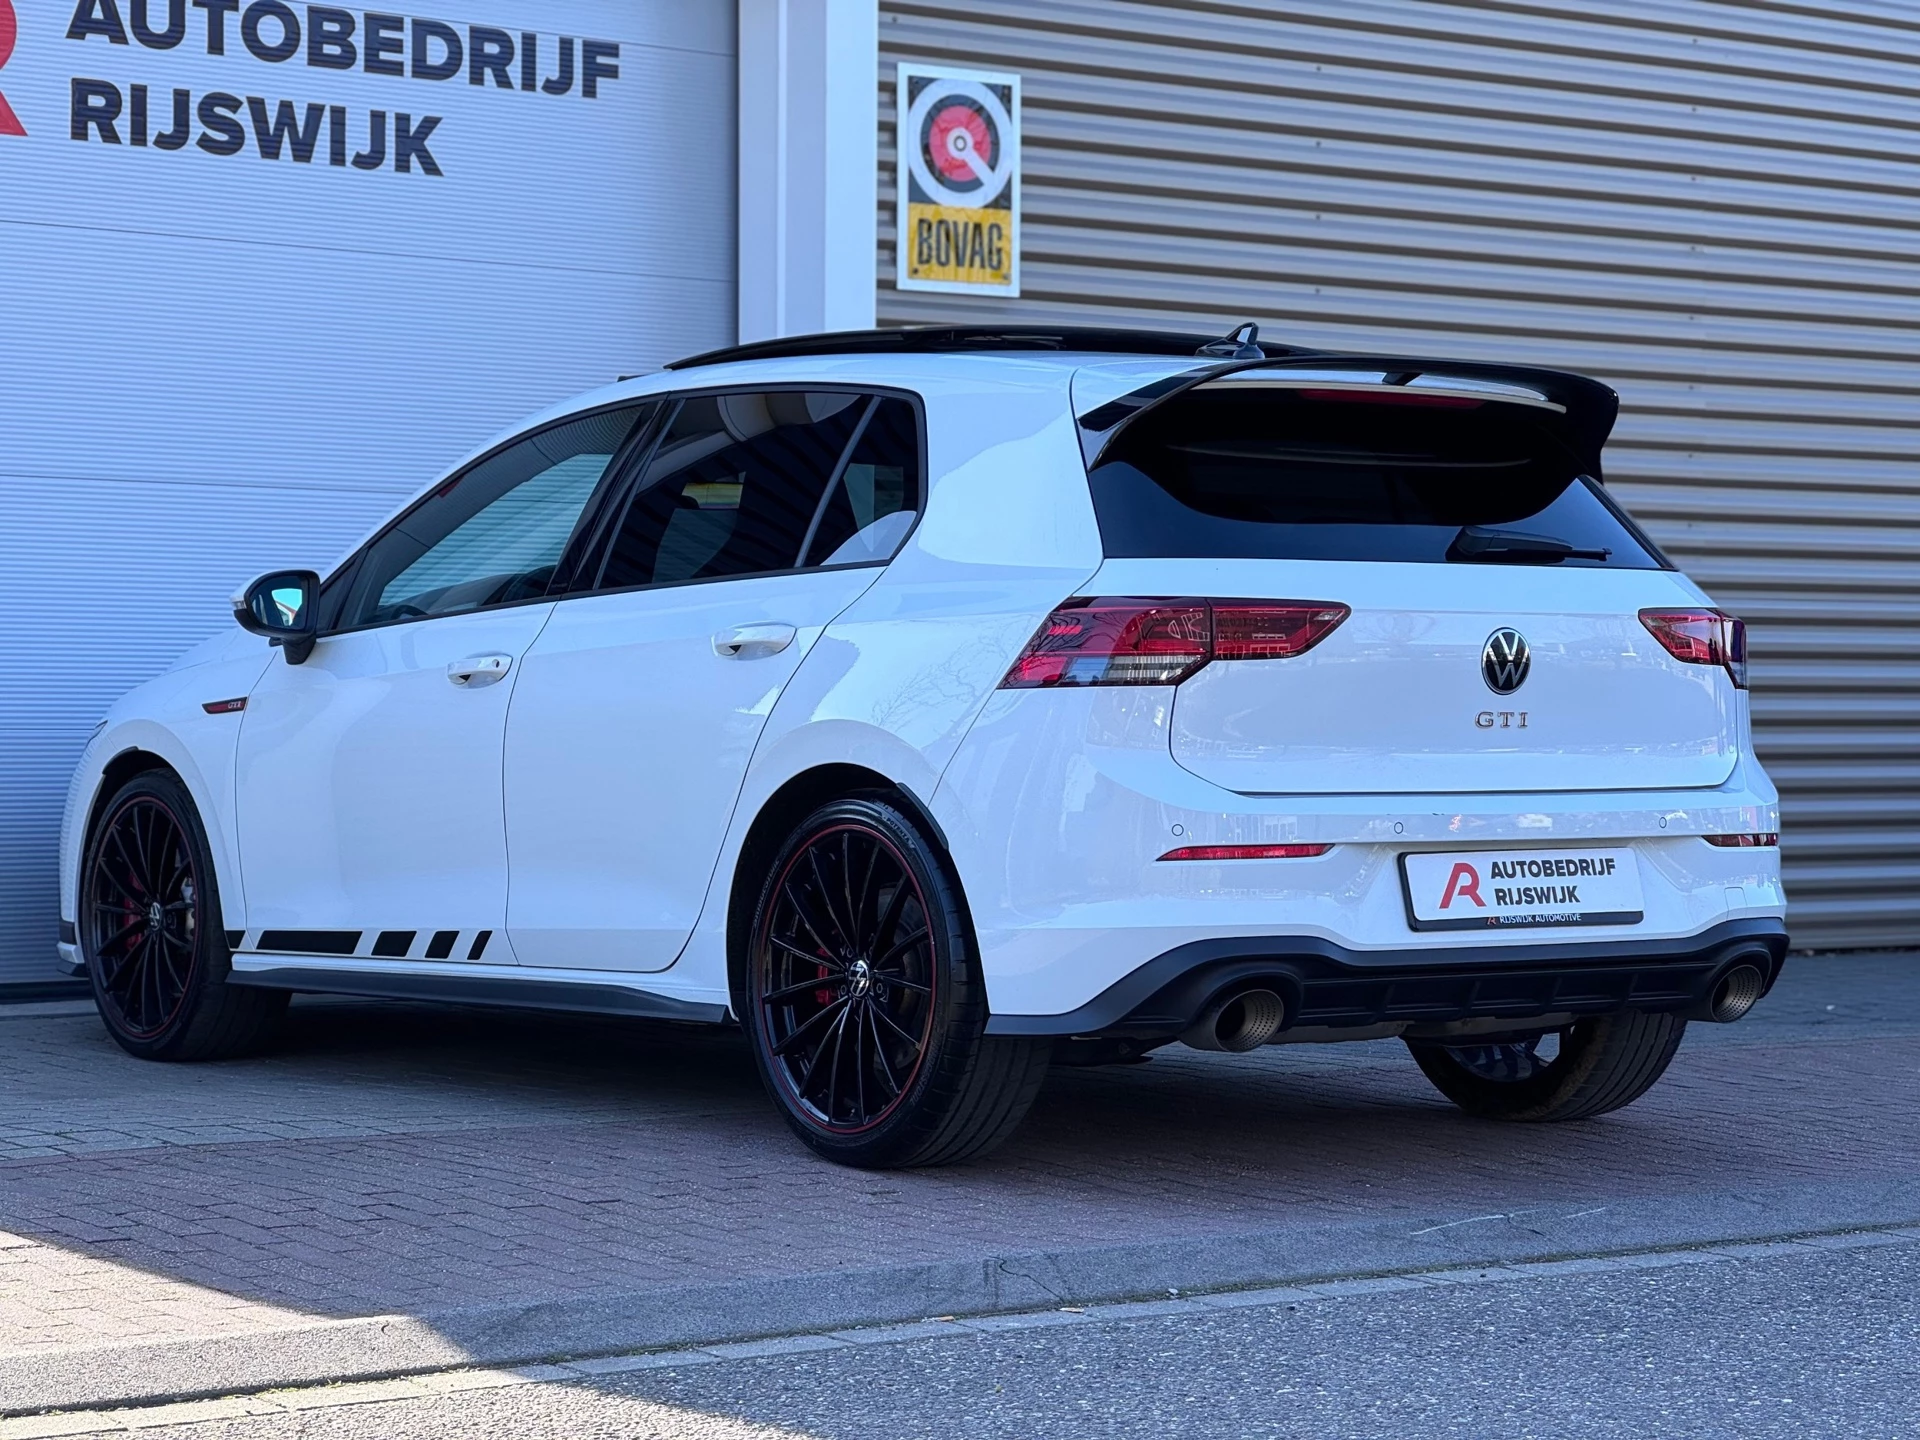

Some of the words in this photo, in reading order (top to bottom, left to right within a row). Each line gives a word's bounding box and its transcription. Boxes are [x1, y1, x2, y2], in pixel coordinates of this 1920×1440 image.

[66, 0, 620, 98] AUTOBEDRIJF
[70, 77, 444, 177] RIJSWIJK
[917, 217, 1004, 271] BOVAG
[1475, 711, 1528, 728] GTI
[1491, 858, 1616, 879] AUTOBEDRIJF
[1495, 885, 1581, 906] RIJSWIJK
[1500, 914, 1534, 924] RIJSWIJK
[1535, 912, 1582, 923] AUTOMOTIVE
